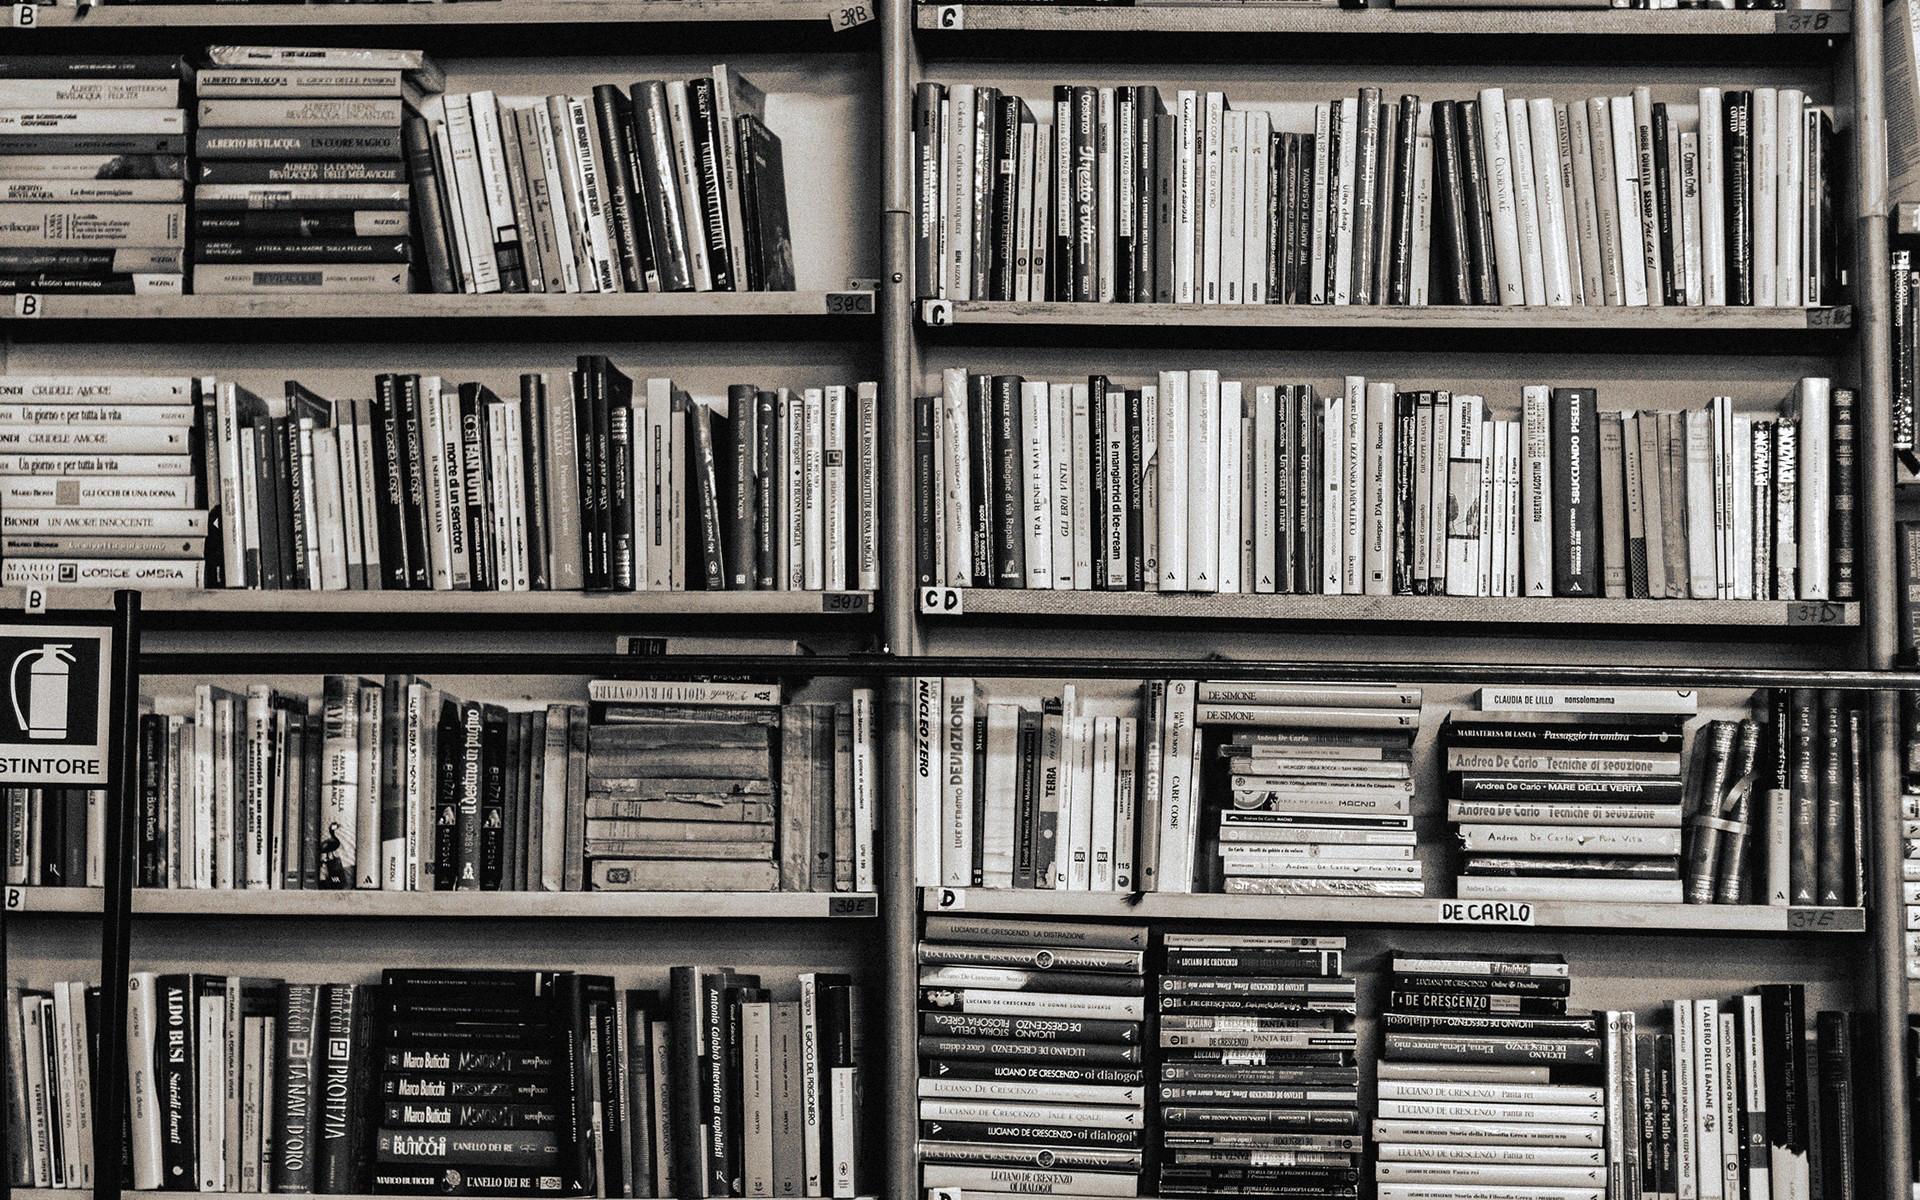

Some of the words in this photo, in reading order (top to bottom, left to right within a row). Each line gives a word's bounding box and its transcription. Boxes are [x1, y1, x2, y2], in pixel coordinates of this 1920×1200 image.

[21, 7, 33, 24] B
[841, 6, 866, 26] 38B
[1789, 14, 1829, 31] 37B
[1081, 95, 1092, 134] Costanzo
[207, 139, 245, 149] ALBERTO
[248, 138, 300, 149] BEVILACQUA
[269, 170, 318, 179] BEVILACQUA
[324, 170, 347, 178] DELLE
[348, 170, 395, 179] MERAVIGLIE
[284, 163, 318, 171] ALBERTO
[1302, 168, 1310, 209] CASANOVA
[1302, 210, 1308, 220] DI
[1644, 221, 1654, 238] Fai
[1647, 241, 1655, 253] da
[1647, 255, 1656, 270] te!
[599, 260, 613, 289] BOMPIANI
[23, 296, 36, 315] B
[932, 305, 945, 325] C
[32, 386, 73, 395] CRUDELE
[77, 386, 111, 396] AMORE
[1003, 383, 1011, 416] RAFFAELE
[22, 407, 32, 419] Un
[34, 407, 58, 424] giorno
[60, 411, 65, 420] e
[67, 411, 79, 424] per
[80, 407, 97, 420] tutta
[100, 407, 106, 420] la
[108, 407, 121, 420] vita
[863, 402, 872, 435] ISABELLA
[1571, 395, 1580, 433] PISELLI
[1003, 418, 1011, 439] CROVI
[289, 422, 300, 486] ALL'ITALIANO
[863, 437, 872, 456] BOSSI
[1112, 441, 1120, 449] le
[446, 443, 458, 476] morte
[864, 458, 873, 498] FEDRIGOTTI
[1003, 449, 1013, 491] L'indagine
[1059, 463, 1068, 490] VINTI
[1110, 451, 1121, 502] mangiatrici
[1279, 454, 1287, 496] Un'estate
[1571, 436, 1580, 504] SBUCCIANDO
[449, 479, 460, 489] di
[1132, 463, 1140, 509] PECCATORE
[292, 489, 301, 511] NON
[449, 490, 460, 504] un
[1060, 496, 1068, 516] EROI
[1279, 498, 1287, 507] al
[1112, 504, 1121, 512] di
[5, 517, 39, 527] BIONDI
[48, 518, 62, 526] UN
[64, 518, 97, 527] AMORE
[100, 518, 153, 527] INNOCENTE
[293, 513, 302, 532] FAR
[450, 506, 464, 553] senatore
[864, 511, 873, 533] BUONA
[1060, 521, 1069, 537] GLI
[1003, 518, 1014, 549] Rapallo
[1112, 514, 1121, 559] ice-cream
[295, 534, 304, 570] SAPERE
[864, 535, 874, 568] FAMIGLIA
[82, 568, 130, 578] CODICE
[136, 568, 183, 578] OMBRA
[30, 591, 41, 608] B
[1799, 605, 1835, 621] 37D
[1209, 691, 1221, 700] DE
[1223, 692, 1256, 701] SIMONE
[1494, 695, 1522, 704] CLAUDIA
[1525, 696, 1533, 704] DE
[1536, 696, 1553, 704] LILLO
[1565, 696, 1614, 704] nonsolomamma
[919, 680, 929, 737] NUCLEO
[465, 709, 482, 747] pugno
[1544, 730, 1586, 741] Passaggio
[1589, 732, 1598, 740] in
[1600, 732, 1629, 741] ombra
[950, 695, 964, 785] DEVIAZIONE
[464, 749, 478, 761] in
[919, 739, 929, 777] ZERO
[1456, 754, 1493, 768] Andrea
[1497, 755, 1510, 768] De
[1513, 756, 1538, 768] Carlo
[1547, 757, 1586, 770] Tecniche
[1591, 757, 1599, 771] di
[1604, 761, 1652, 771] seduzione
[460, 763, 478, 805] destino
[1046, 767, 1057, 797] TERRA
[1172, 776, 1180, 802] CARE
[1476, 782, 1504, 790] Andrea
[1507, 782, 1517, 790] De
[1549, 783, 1575, 791] MARE
[1579, 783, 1607, 791] DELLE
[463, 805, 476, 814] il
[1171, 805, 1179, 830] COSE
[8, 890, 20, 907] B
[940, 890, 955, 907] D
[1443, 904, 1464, 920] DE
[1468, 904, 1530, 921] CARLO
[1793, 910, 1834, 926] 37E
[168, 987, 183, 1026] ALDO
[710, 989, 719, 1024] Antonio
[1406, 995, 1419, 1006] DE
[1423, 996, 1487, 1008] CRESCENZO
[1703, 1006, 1711, 1045] L'ALBERO
[169, 1030, 184, 1063] BUSI
[711, 1026, 720, 1060] Calabrò
[403, 1052, 424, 1068] Marco
[425, 1053, 449, 1069] Buticchi
[806, 1062, 814, 1076] DEL
[1704, 1047, 1712, 1071] DELLE
[712, 1062, 722, 1103] Intervista
[995, 1067, 1026, 1077] LUCIANO
[1028, 1069, 1038, 1077] DE
[1039, 1069, 1079, 1079] CRESCENZO
[1085, 1070, 1094, 1079] oi
[1705, 1073, 1713, 1108] BANANE
[714, 1105, 721, 1114] ai
[807, 1077, 815, 1126] PRIGIONIERO
[1662, 1098, 1670, 1110] de
[1662, 1113, 1671, 1139] Mello
[713, 1116, 723, 1158] capitalisti
[394, 1142, 446, 1156] BUTICCHI
[467, 1177, 502, 1187] L'ANELLO
[505, 1177, 518, 1187] DEI
[520, 1177, 530, 1188] RE
